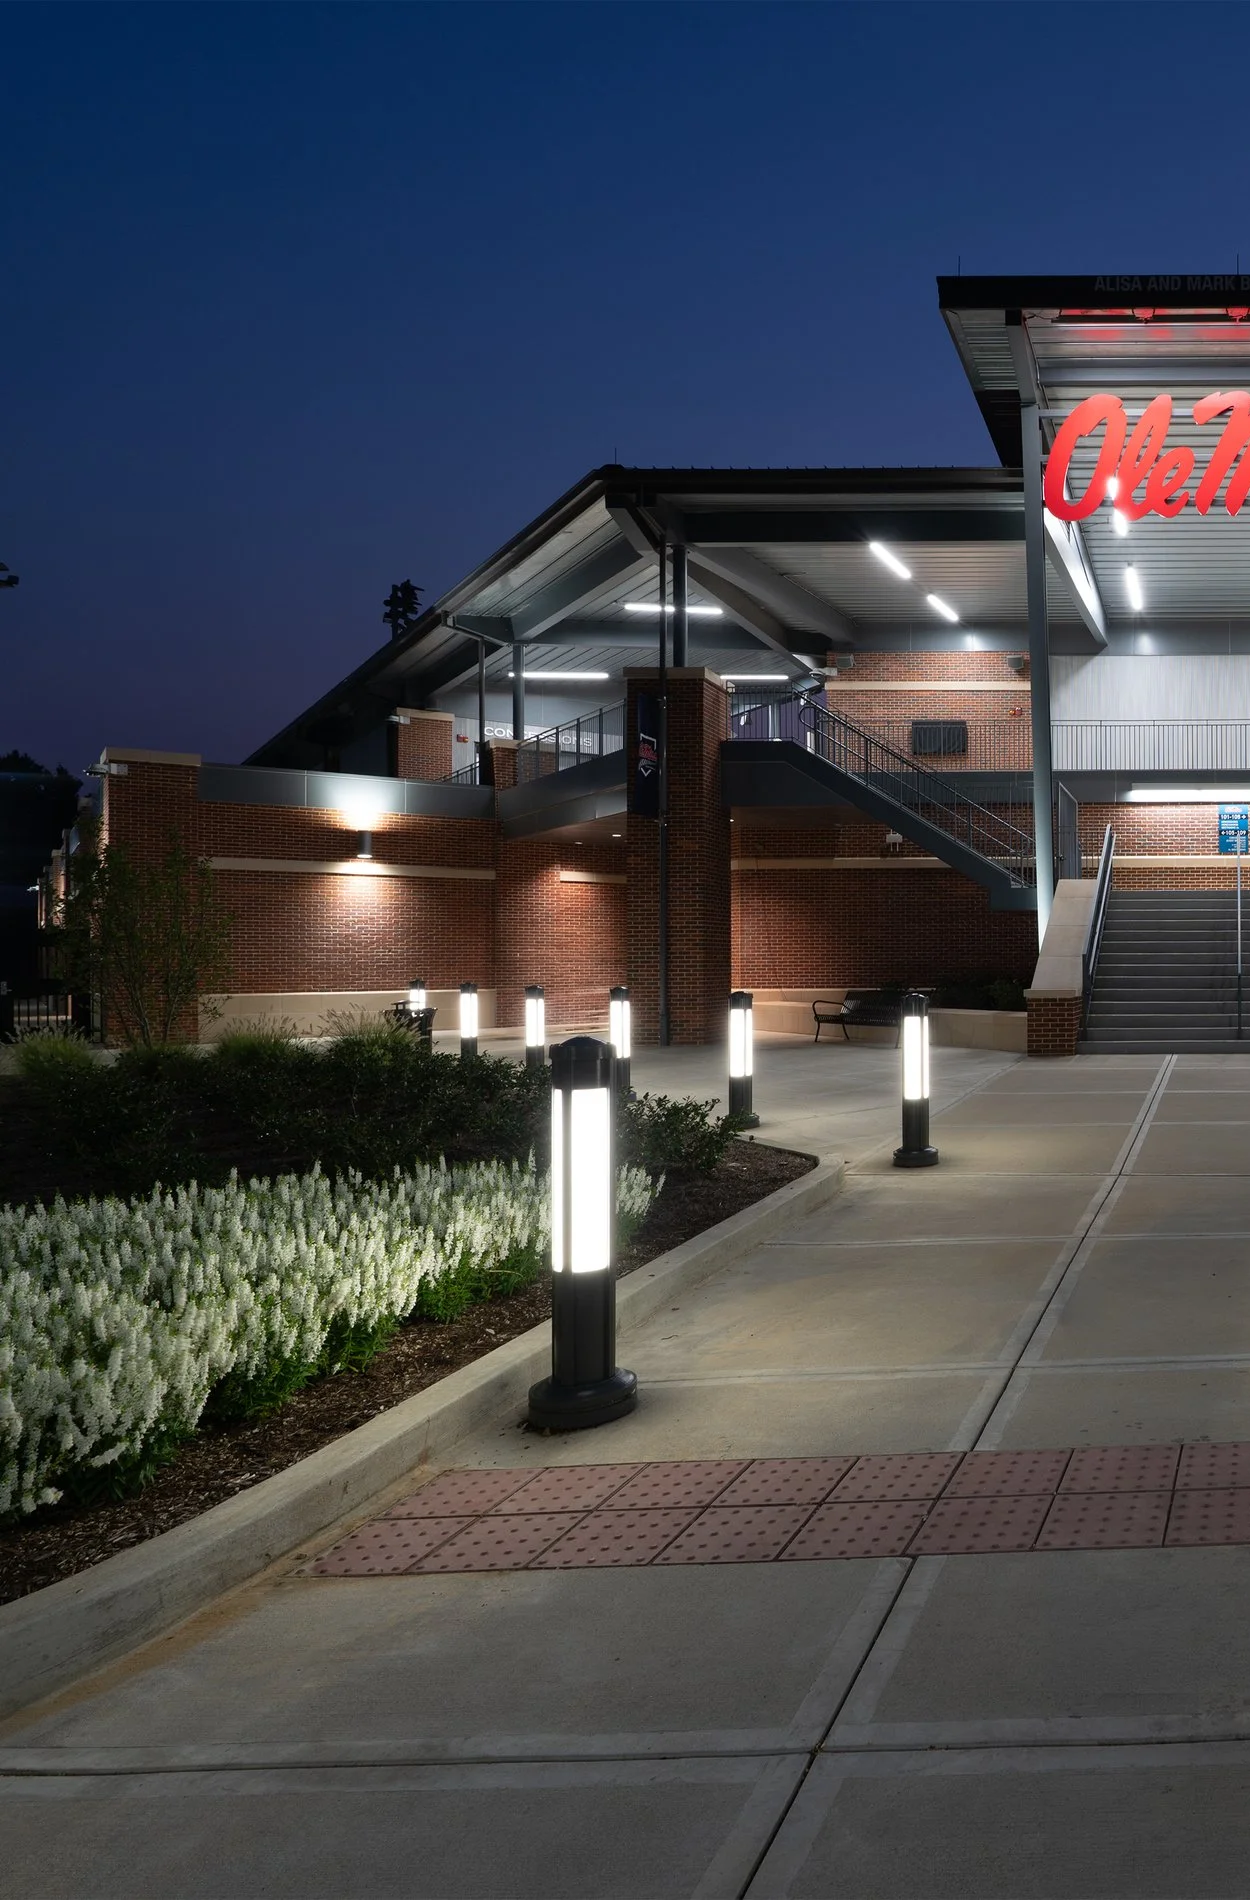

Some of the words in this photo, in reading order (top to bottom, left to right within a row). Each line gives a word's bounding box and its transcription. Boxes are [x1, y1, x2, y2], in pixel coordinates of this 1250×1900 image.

[1094, 276, 1142, 292] ALISA
[1147, 276, 1181, 291] AND
[1187, 276, 1235, 291] MARK
[1043, 393, 1195, 522] Ole
[484, 726, 592, 747] CONESSIONS
